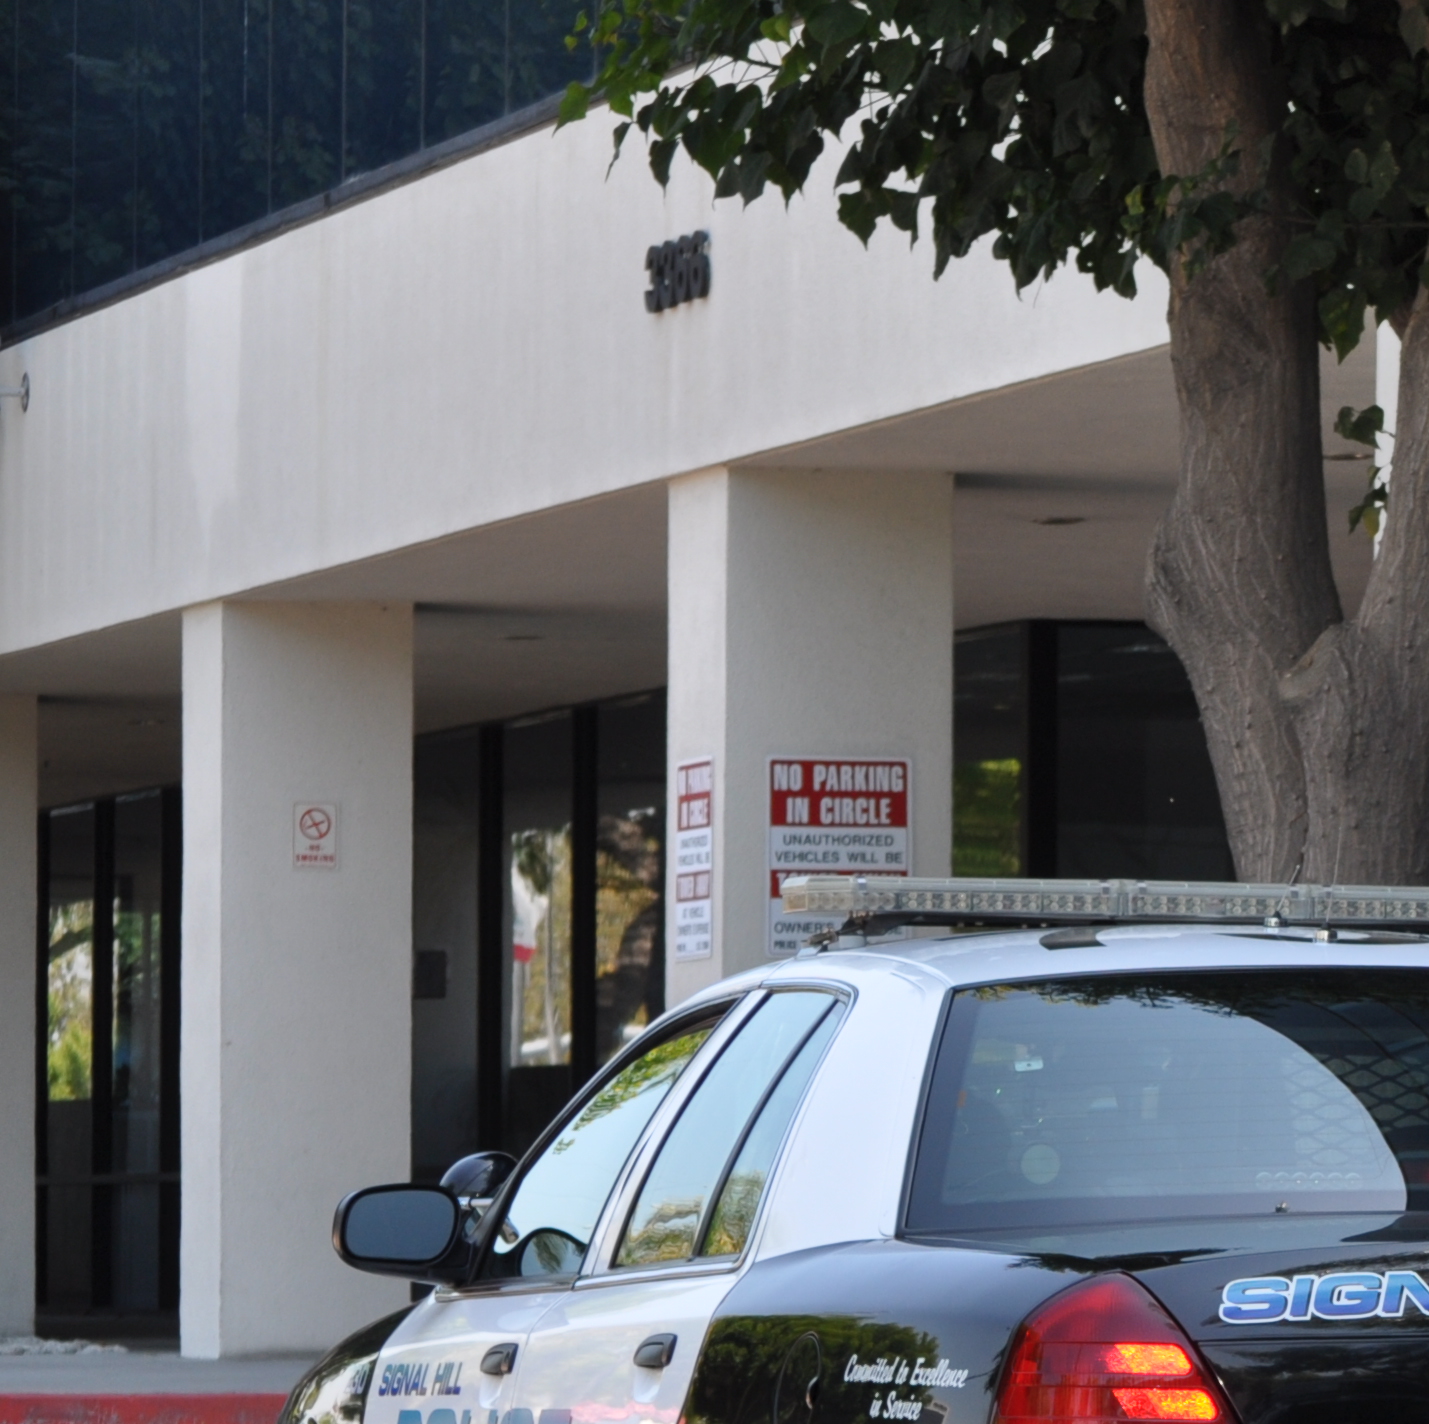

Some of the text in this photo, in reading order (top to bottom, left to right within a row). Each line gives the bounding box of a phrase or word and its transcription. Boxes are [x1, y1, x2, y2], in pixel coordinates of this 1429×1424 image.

[773, 763, 904, 793] NO PARKING
[785, 796, 892, 825] IN CIRCLE
[782, 833, 895, 848] UNAUTHORIZED
[774, 850, 904, 864] VEHICLES WILL BE
[378, 1361, 463, 1396] SIGNAL HILL
[843, 1353, 969, 1388] Committed to Excellence
[869, 1390, 923, 1421] in Service
